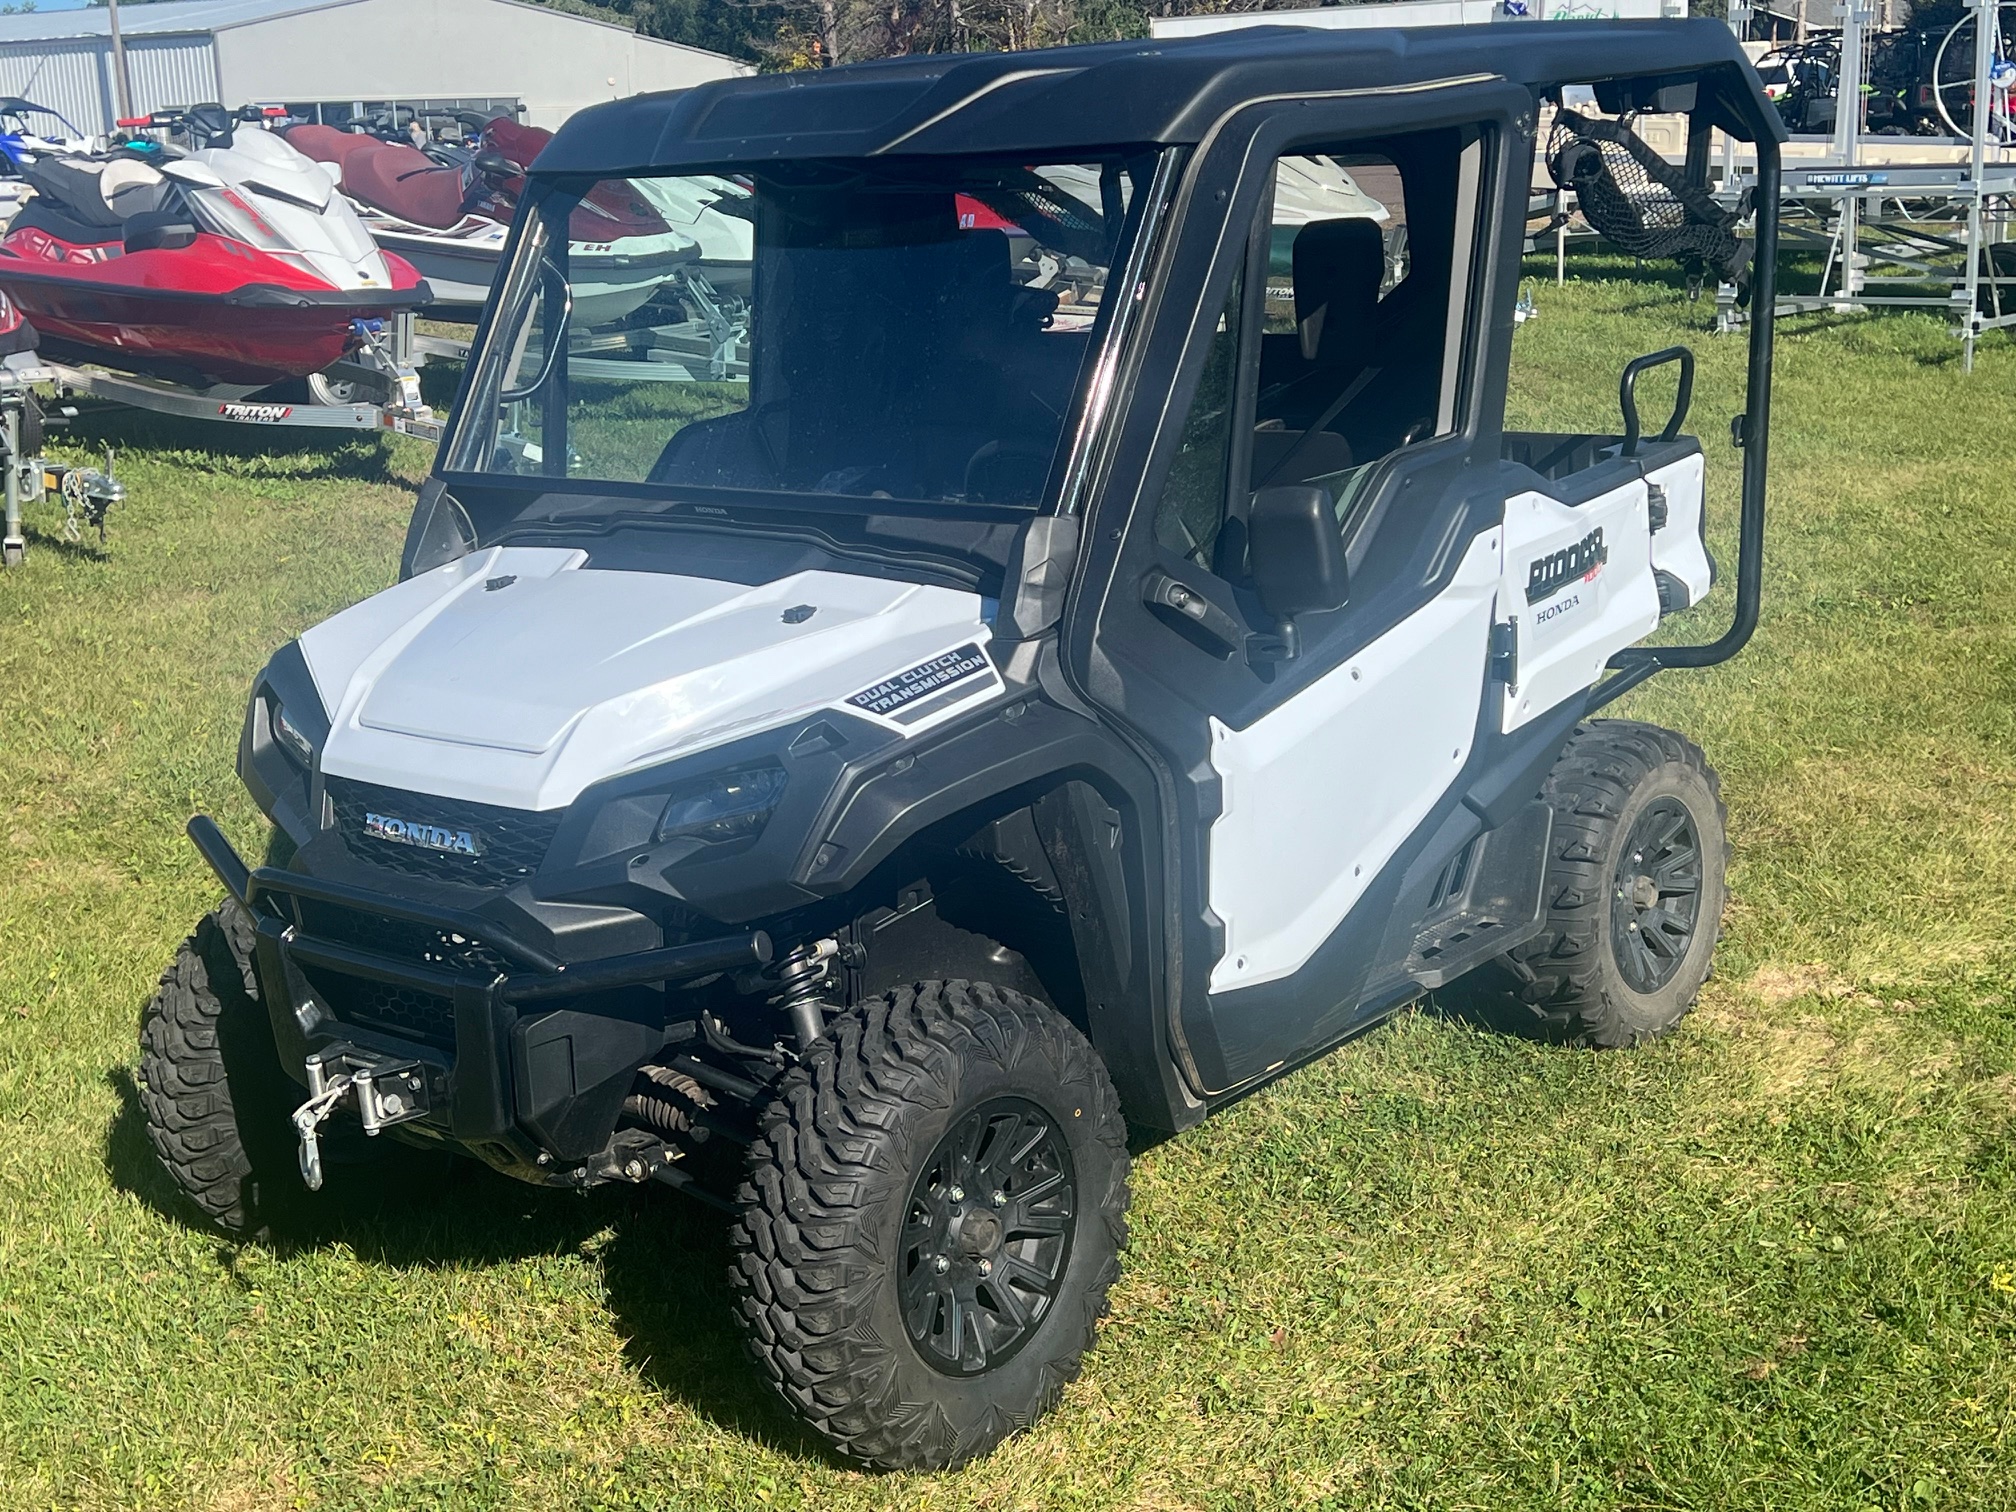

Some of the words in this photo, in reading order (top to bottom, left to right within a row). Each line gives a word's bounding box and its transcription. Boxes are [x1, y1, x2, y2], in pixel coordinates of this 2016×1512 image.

[1845, 174, 1868, 184] LIFTS
[225, 403, 287, 418] TRITON
[694, 506, 729, 515] HONDA
[1536, 594, 1580, 625] HONDA
[855, 681, 900, 706] DUAL
[900, 651, 963, 684] CLUTCH
[868, 654, 986, 713] TRANSMISSION
[364, 812, 479, 857] HONDA
